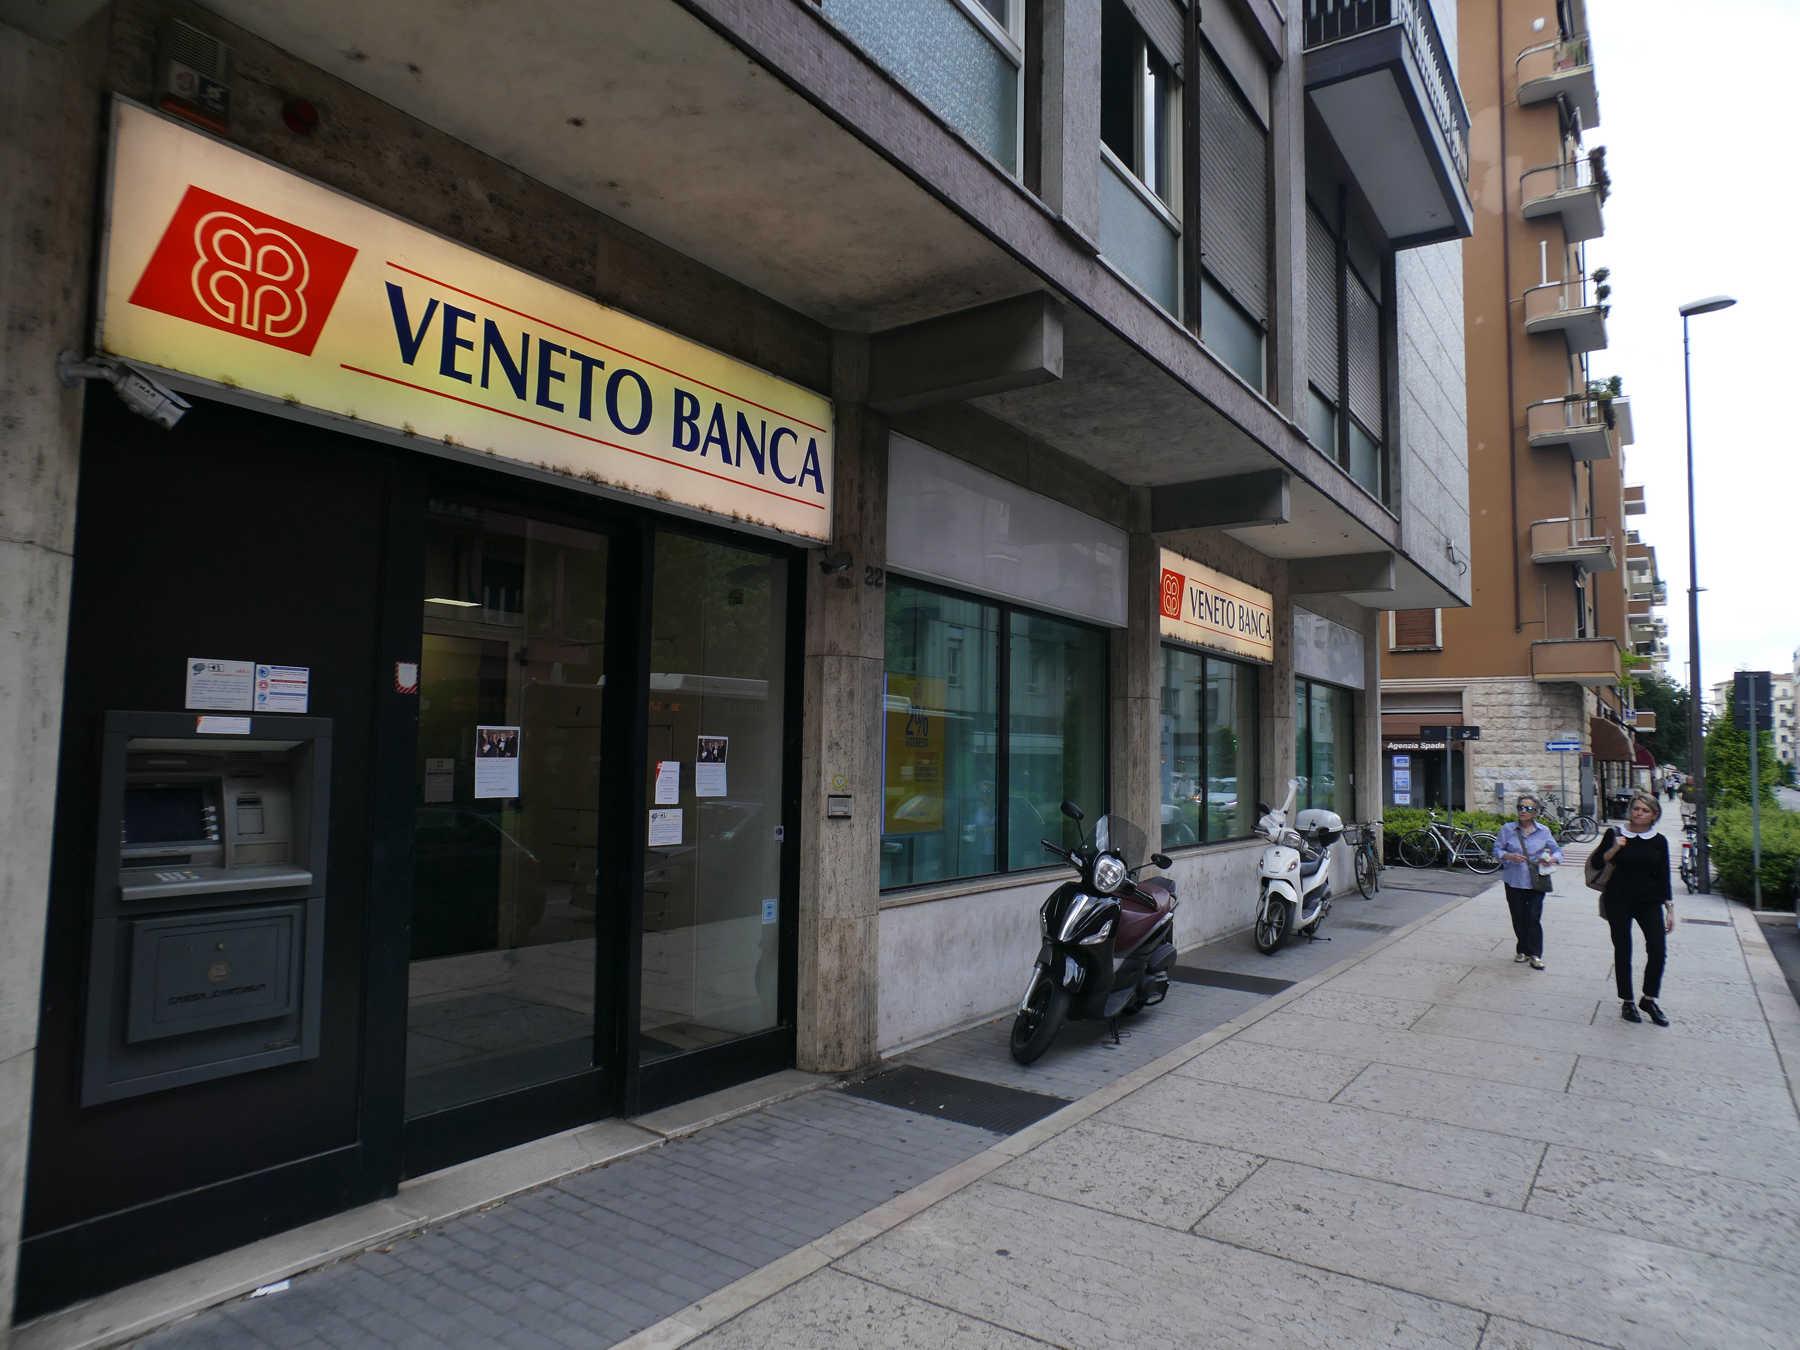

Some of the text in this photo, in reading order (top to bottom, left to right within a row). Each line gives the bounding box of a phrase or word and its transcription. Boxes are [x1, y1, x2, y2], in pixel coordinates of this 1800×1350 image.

[385, 281, 825, 495] VENETO BANCA
[865, 565, 884, 587] 22
[1189, 586, 1272, 641] VENETO BANCA
[1387, 742, 1445, 750] Agenzia Spada
